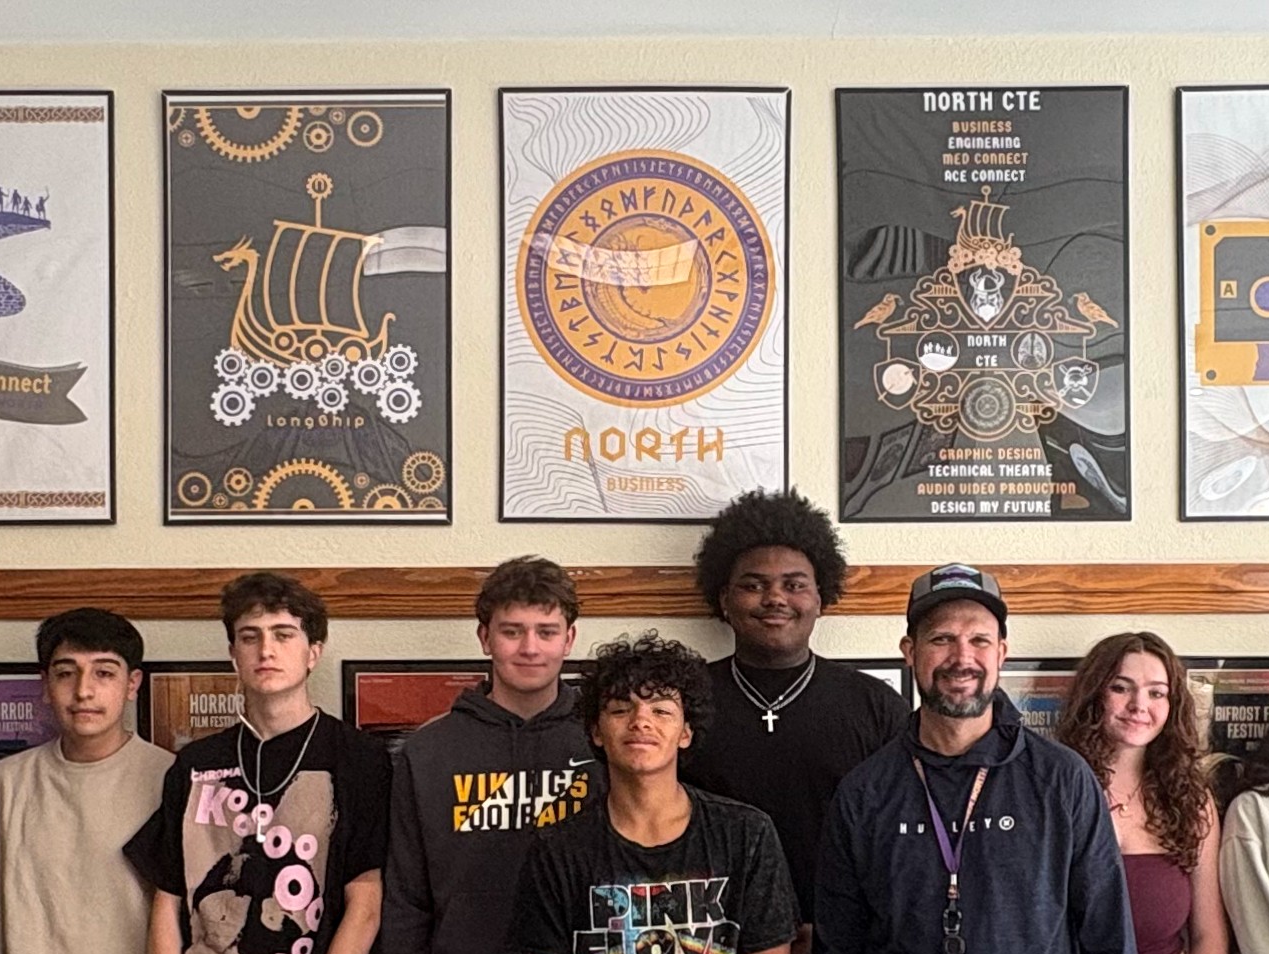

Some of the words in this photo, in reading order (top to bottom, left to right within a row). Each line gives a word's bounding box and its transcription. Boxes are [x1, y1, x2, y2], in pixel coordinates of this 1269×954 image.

[924, 91, 993, 112] NORTH
[1002, 91, 1041, 111] CTE
[952, 120, 1012, 133] BUSINESS
[942, 153, 970, 165] MED
[974, 152, 1028, 165] CONNECT
[944, 170, 967, 182] ACE
[971, 169, 1026, 182] CONNECT
[967, 335, 1007, 347] NORTH
[975, 354, 998, 367] CTE
[563, 425, 724, 464] NORTH
[939, 448, 993, 460] GRAPHIC
[998, 447, 1041, 460] DESIGN
[928, 465, 994, 477] TECHNICAL
[998, 464, 1052, 476] THEATRE
[606, 476, 686, 492] BUSINESS
[917, 483, 956, 495] AUDIO
[959, 482, 995, 495] VIDEO
[1000, 481, 1076, 495] PRODUCTION
[931, 501, 975, 513] DESIGN
[980, 501, 999, 513] MY
[1004, 501, 1051, 513] FUTURE
[190, 694, 245, 714] HORROR
[1215, 706, 1260, 721] BIFROST
[191, 716, 208, 728] FILM
[900, 816, 992, 834] HULEY
[590, 877, 729, 931] PINK
